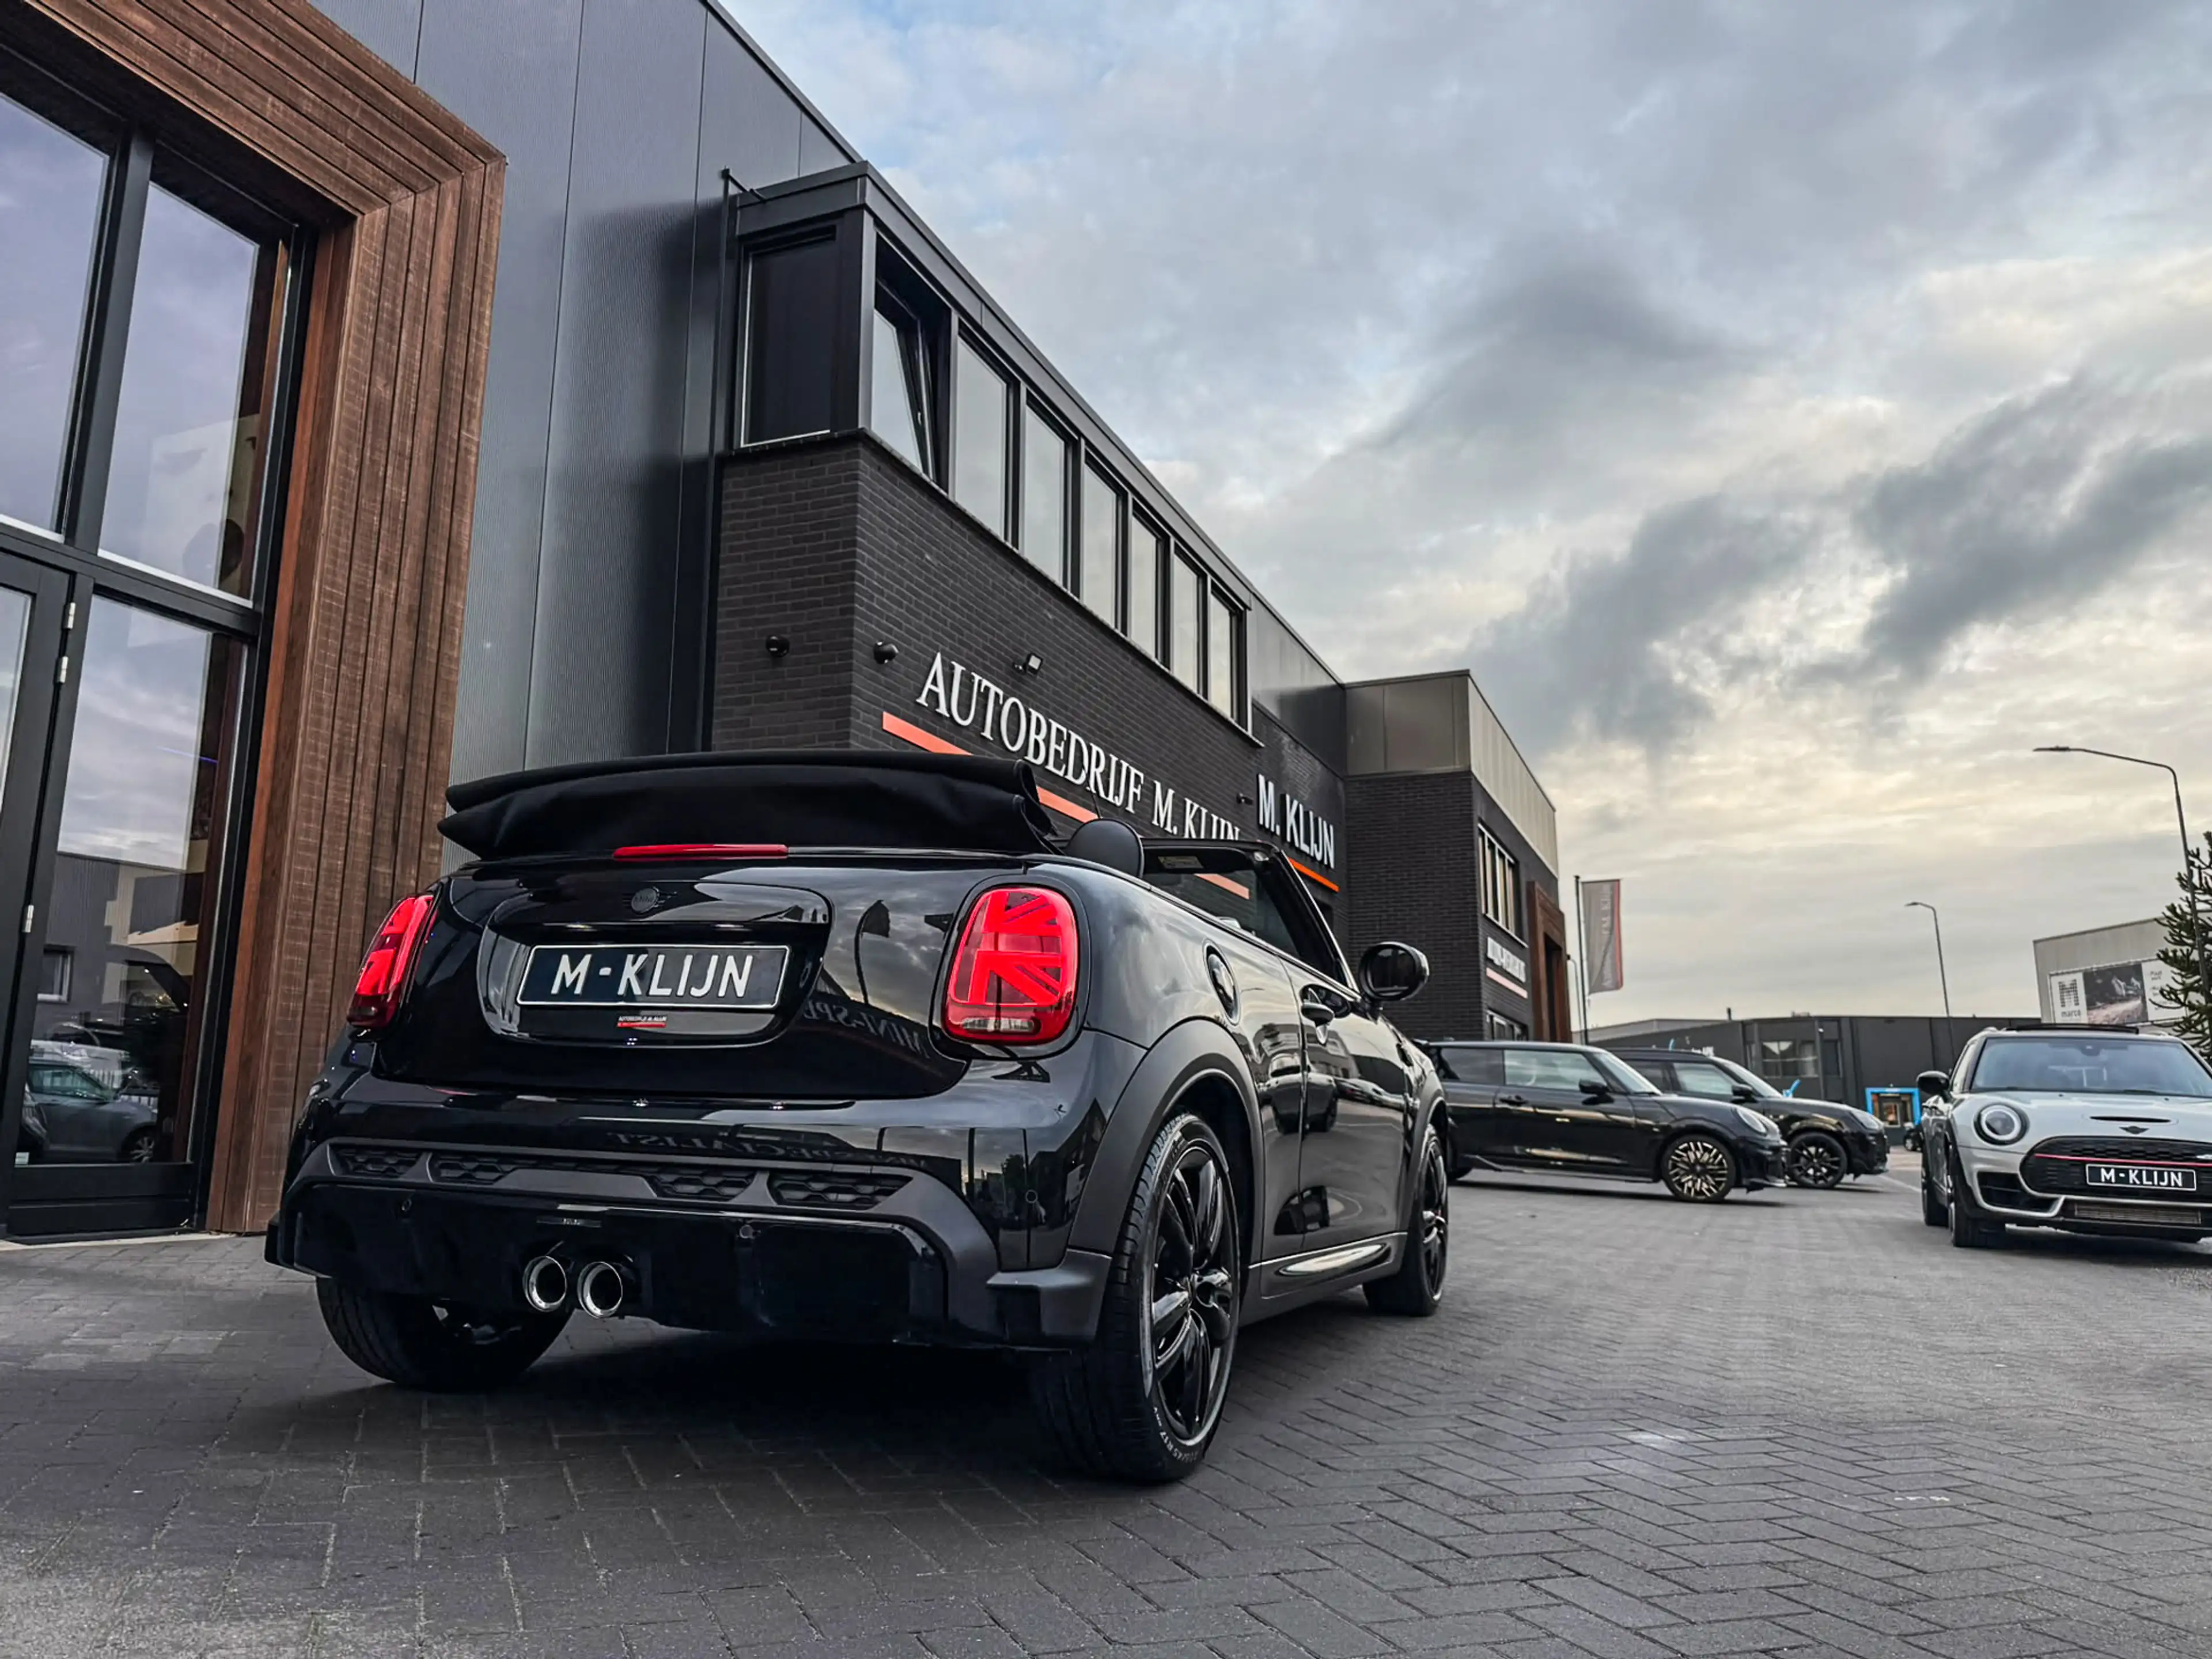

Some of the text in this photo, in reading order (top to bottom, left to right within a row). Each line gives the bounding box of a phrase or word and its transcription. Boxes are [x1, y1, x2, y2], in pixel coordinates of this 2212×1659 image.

[916, 652, 1144, 813] AUTOBEDRIJF
[1152, 779, 1177, 835] M.
[1258, 773, 1335, 869] M. KLIJN
